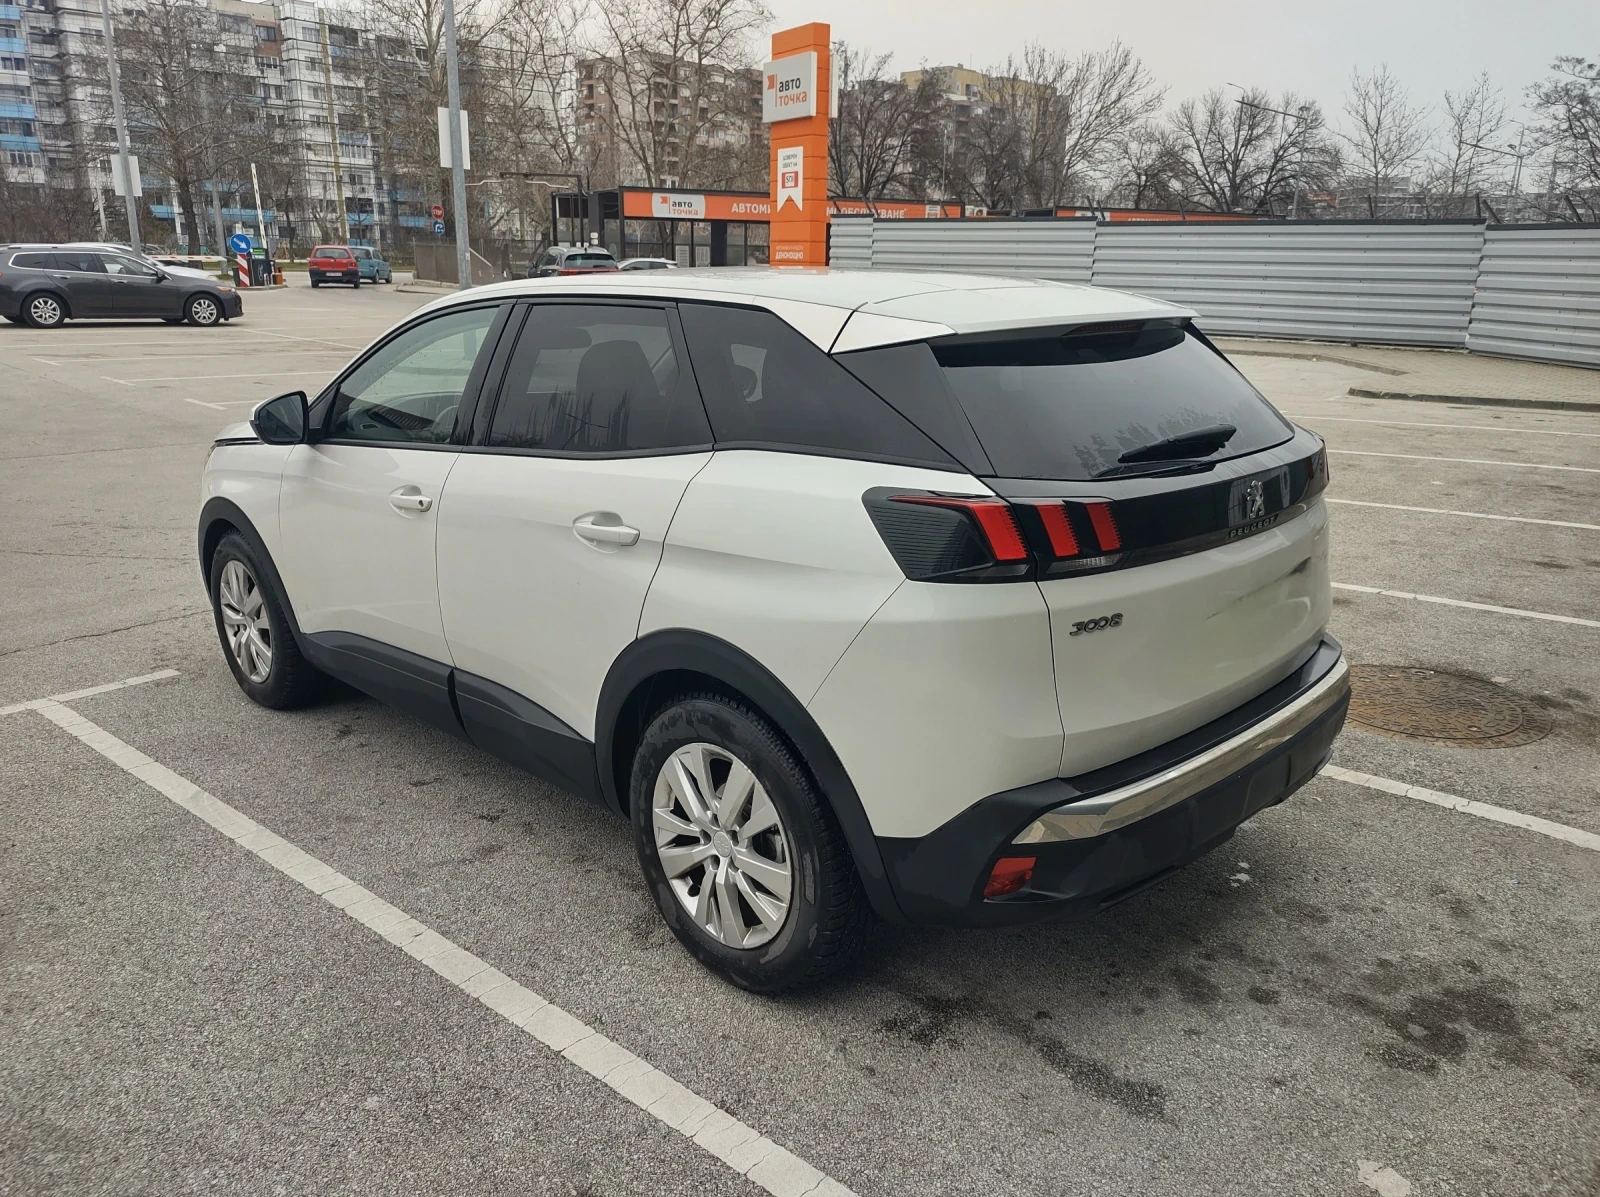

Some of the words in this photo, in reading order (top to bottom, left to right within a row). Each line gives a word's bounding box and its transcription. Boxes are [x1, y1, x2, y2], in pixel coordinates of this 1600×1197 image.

[778, 77, 801, 93] авто
[778, 91, 807, 107] точка
[671, 200, 693, 208] авто
[672, 208, 699, 216] точка
[1230, 516, 1275, 538] PEUGEOT
[1069, 612, 1124, 636] 3008
